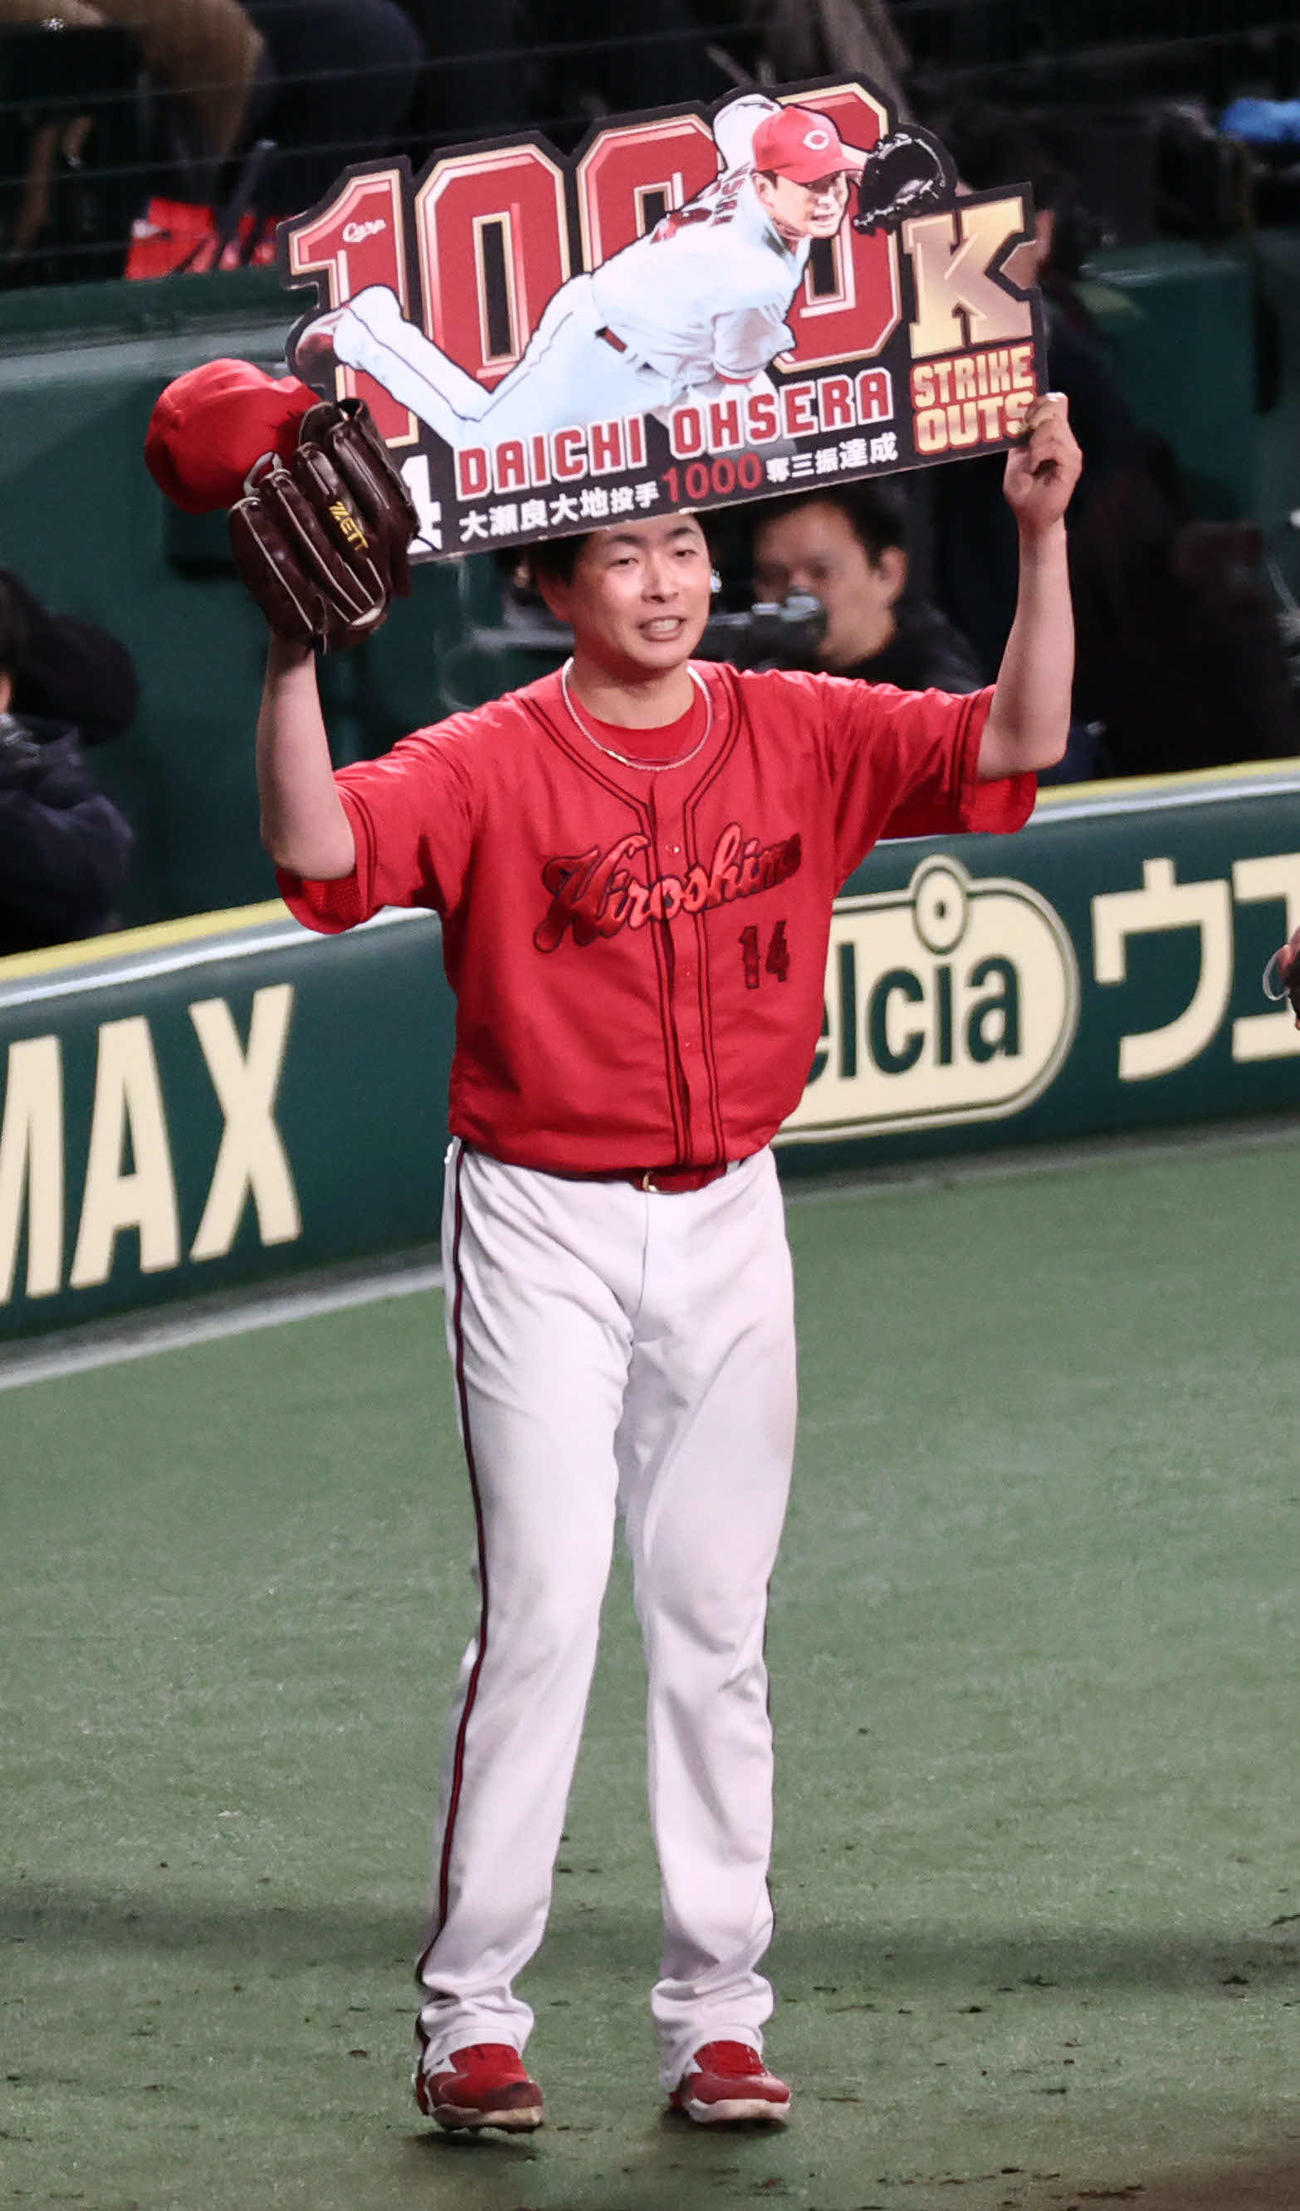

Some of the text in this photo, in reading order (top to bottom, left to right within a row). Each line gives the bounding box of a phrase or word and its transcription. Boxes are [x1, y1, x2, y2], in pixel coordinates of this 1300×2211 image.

[343, 218, 387, 243] Carp
[910, 342, 1036, 410] STRIKE
[454, 367, 894, 501] DAICHI OHSERA
[914, 391, 1036, 455] OUTS
[662, 453, 763, 502] 1000
[329, 501, 369, 550] ZETT
[739, 920, 789, 989] 14
